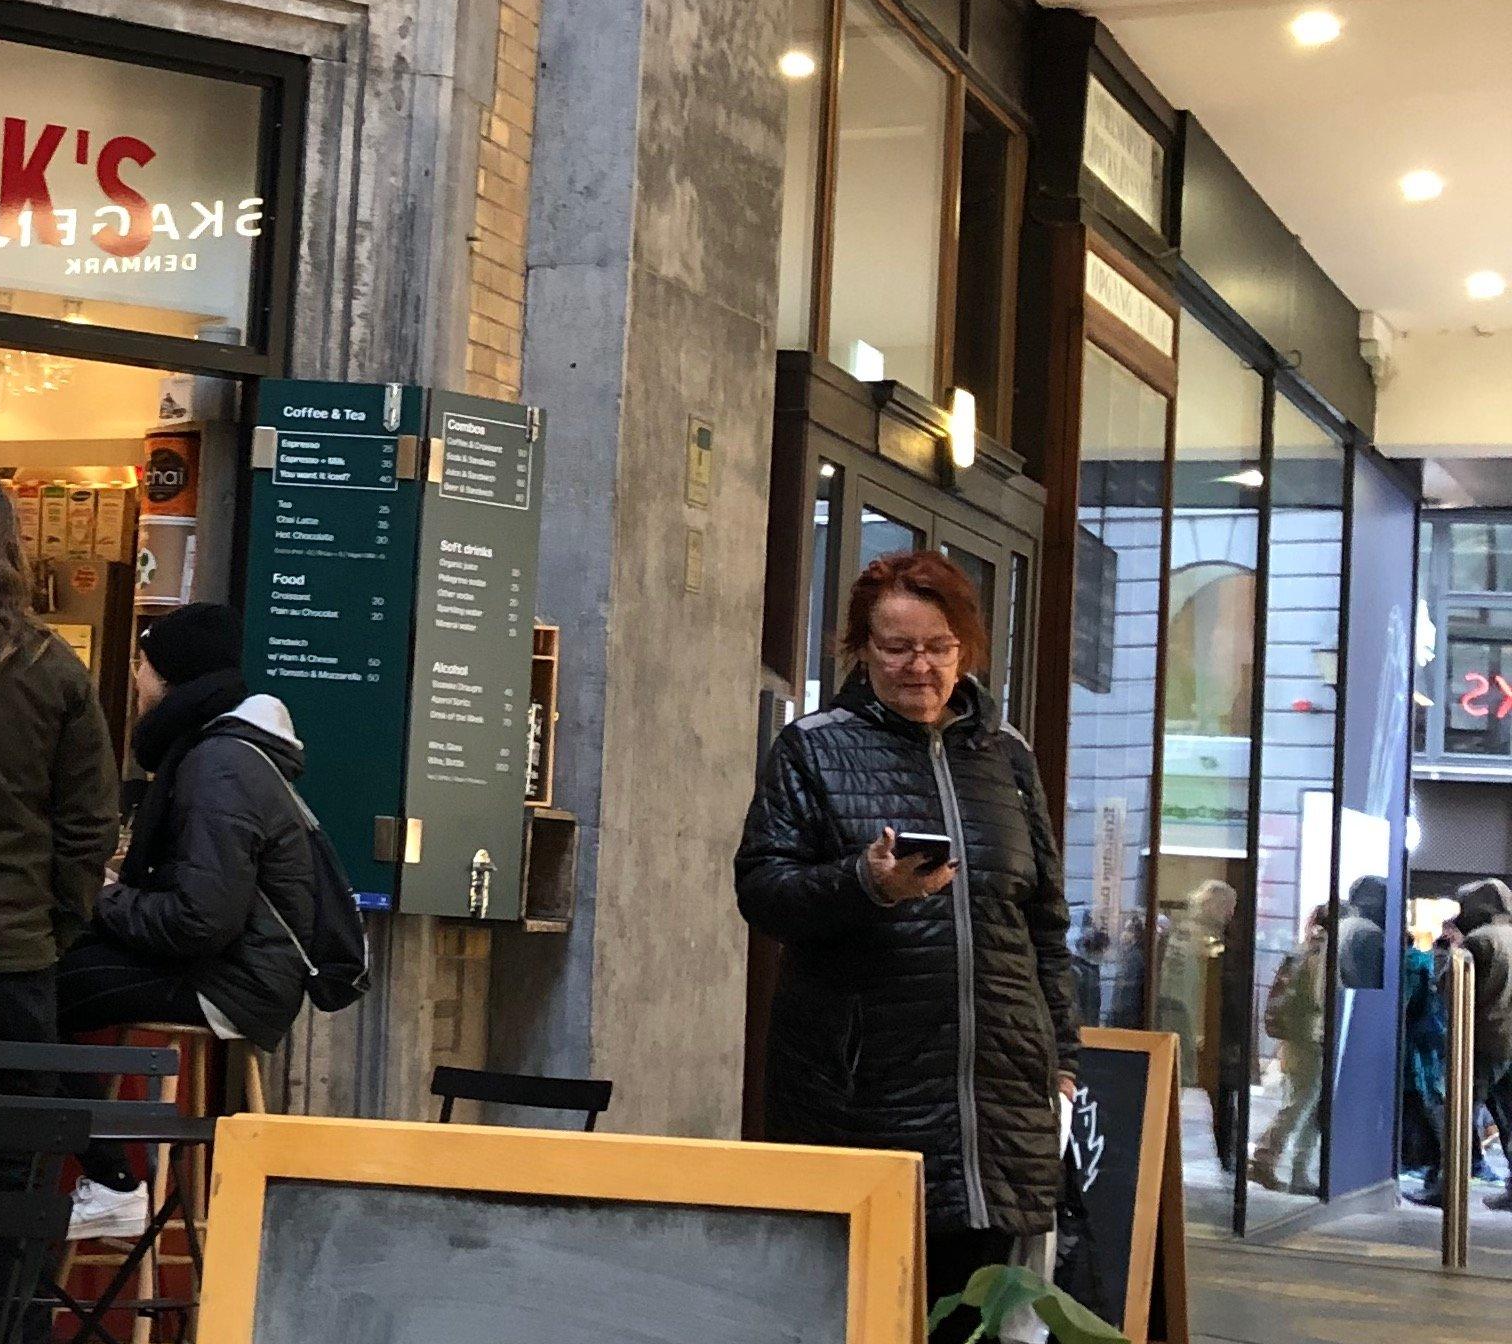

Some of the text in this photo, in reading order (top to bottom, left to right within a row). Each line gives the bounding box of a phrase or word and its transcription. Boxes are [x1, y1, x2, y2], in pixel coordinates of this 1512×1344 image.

[283, 406, 366, 421] Coffee & Tea
[448, 419, 486, 436] Combos
[145, 468, 184, 486] chai
[440, 539, 493, 558] Soft drinks
[273, 573, 305, 585] Food
[432, 661, 468, 676] Alcohol
